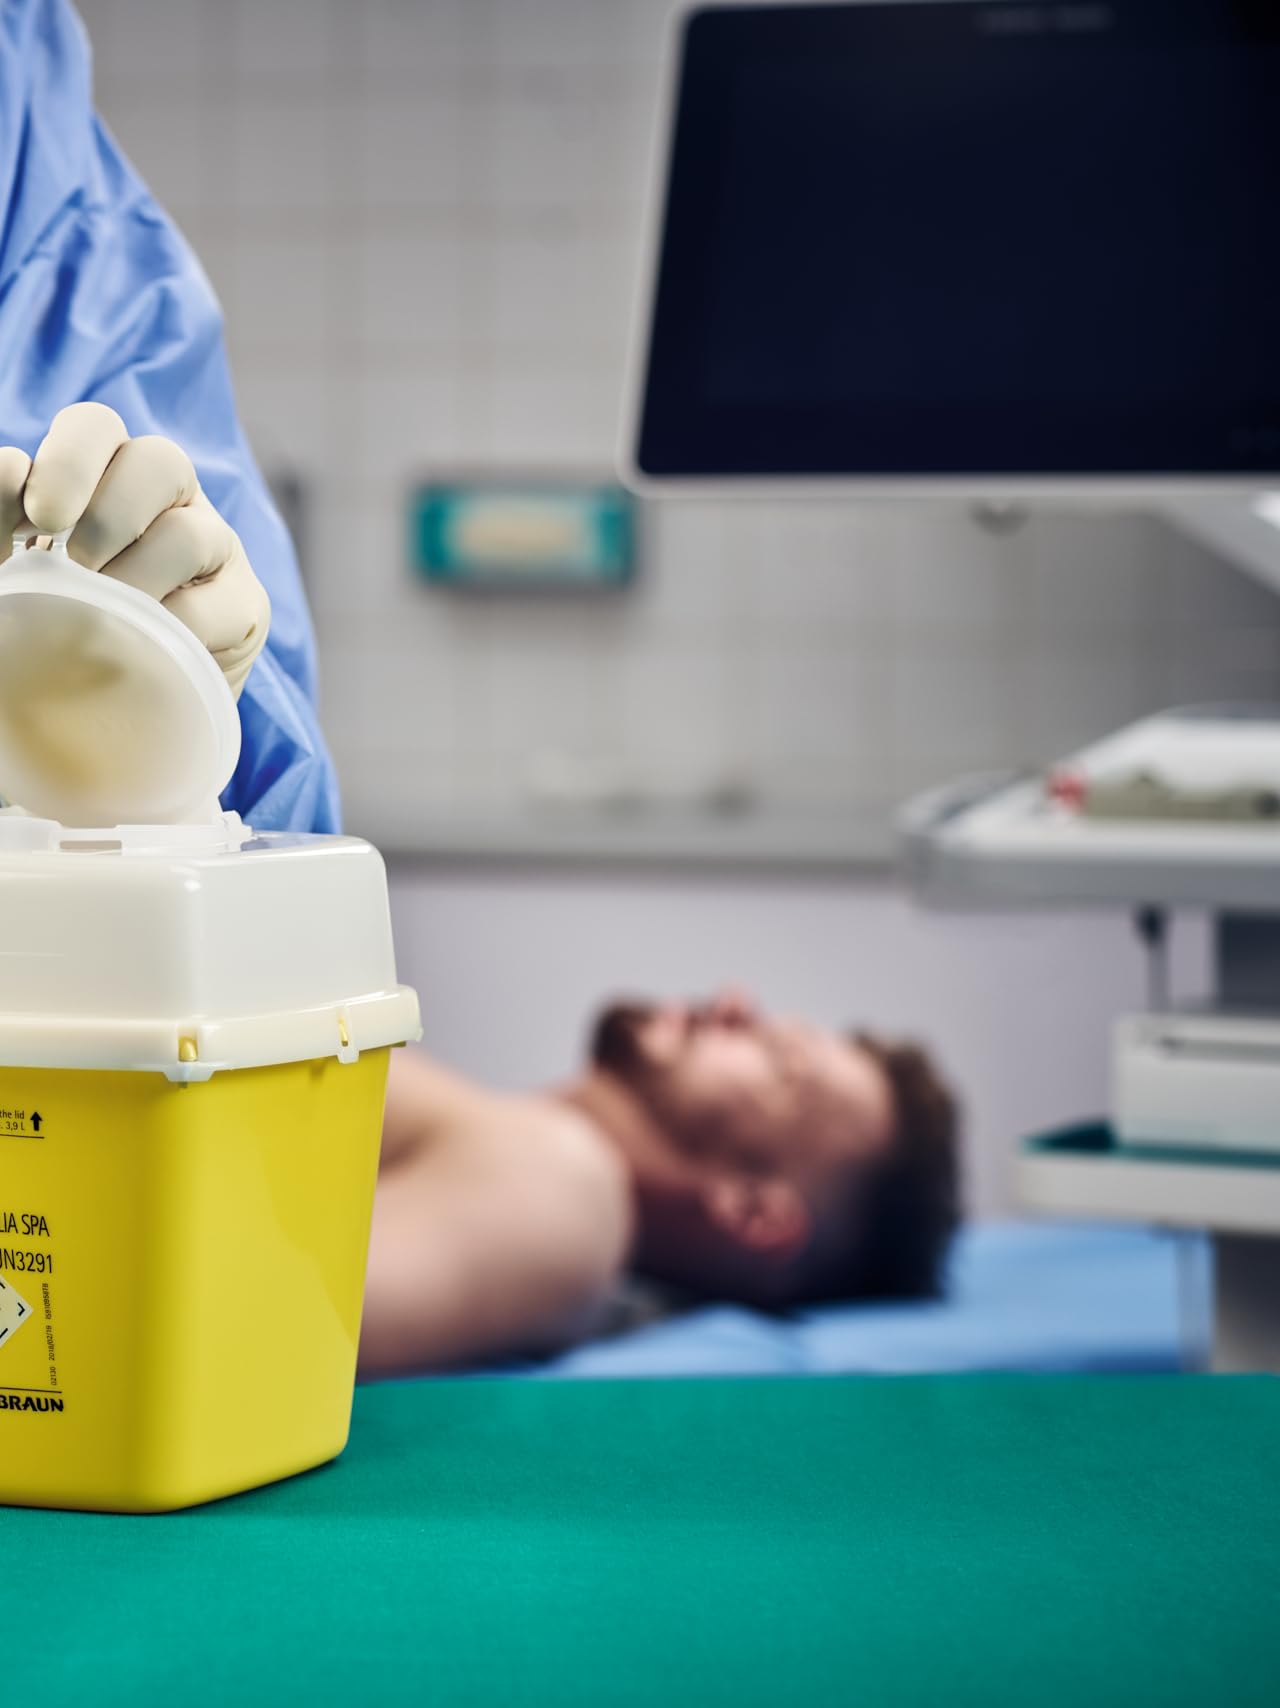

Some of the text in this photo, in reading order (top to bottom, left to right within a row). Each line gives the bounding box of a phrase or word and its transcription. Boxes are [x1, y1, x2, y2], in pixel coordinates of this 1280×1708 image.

[0, 1109, 12, 1119] the
[14, 1110, 25, 1119] lid
[5, 1121, 18, 1131] 3,9
[20, 1121, 25, 1130] L
[22, 1214, 50, 1237] SPA
